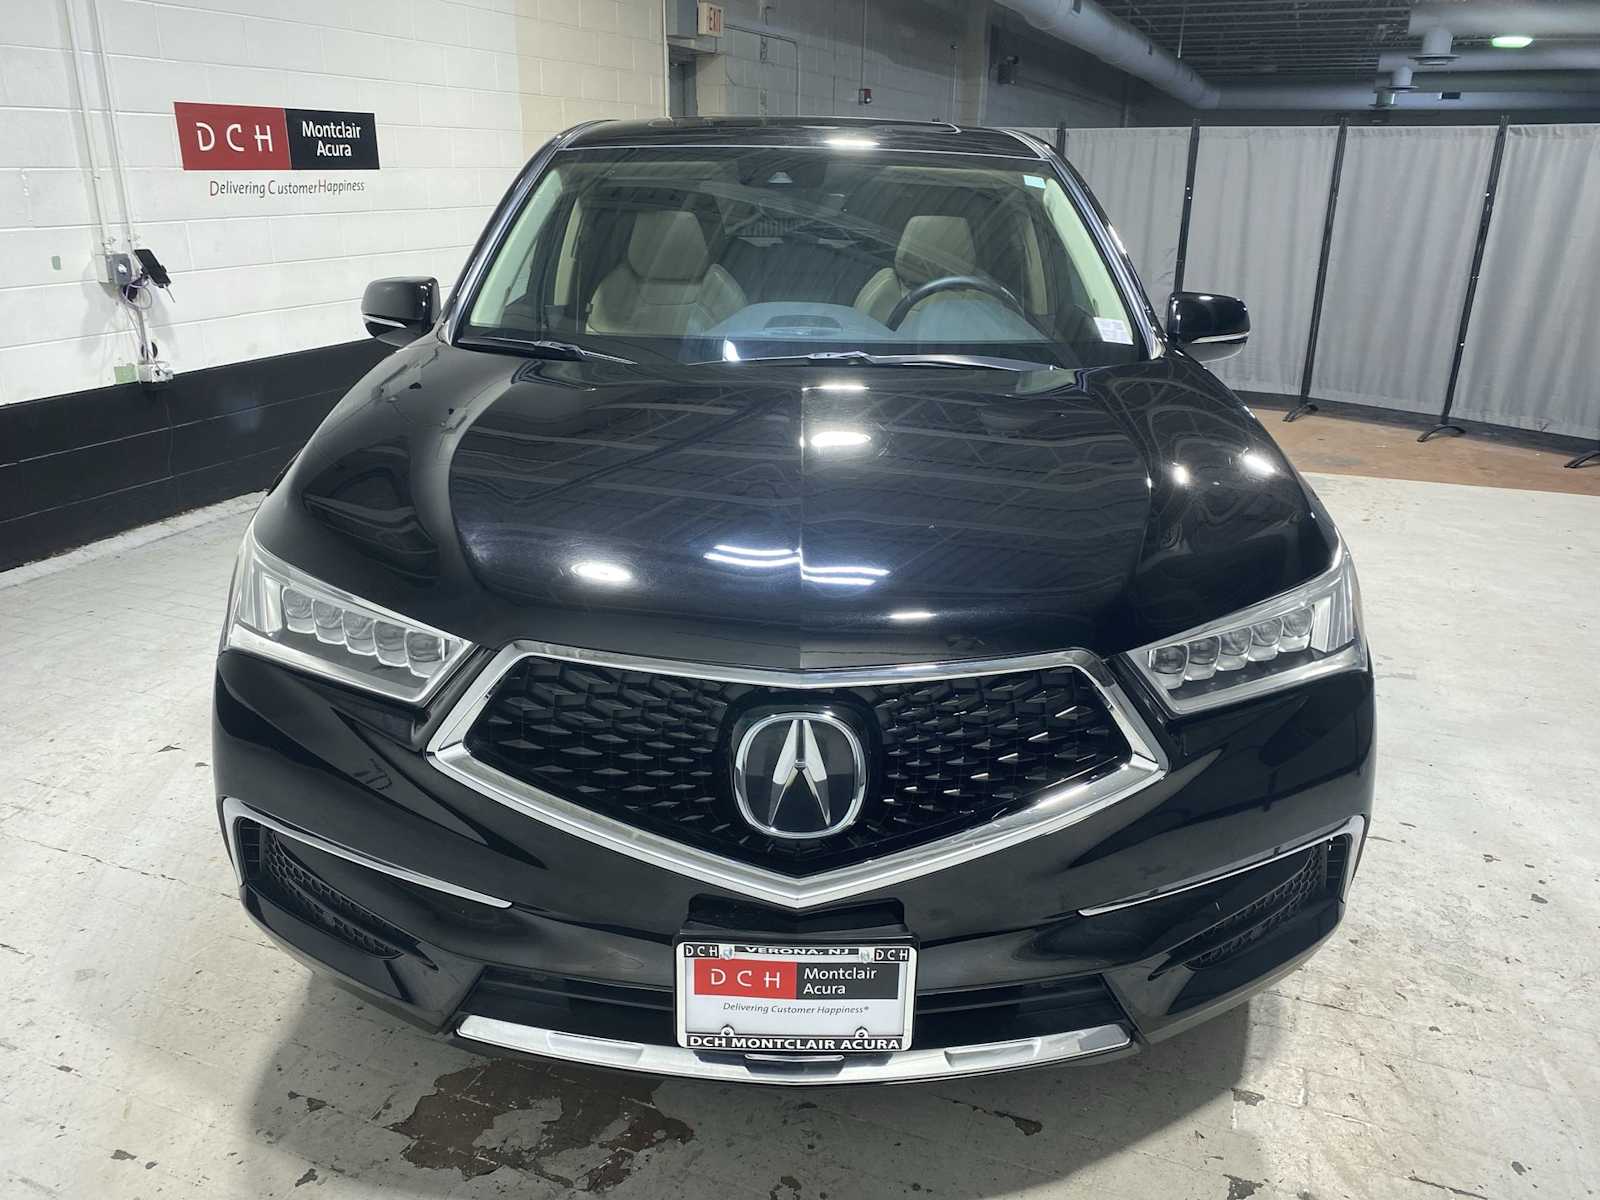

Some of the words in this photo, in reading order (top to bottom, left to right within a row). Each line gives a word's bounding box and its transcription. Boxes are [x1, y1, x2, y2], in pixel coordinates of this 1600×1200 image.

[196, 122, 274, 152] DCH
[302, 121, 361, 139] Montclair
[316, 141, 352, 157] Acura
[209, 180, 265, 198] Delivering
[685, 945, 718, 957] DCH
[875, 949, 908, 961] DCH
[710, 968, 781, 989] DCH
[803, 967, 877, 980] Montclair
[803, 983, 846, 995] Acura
[723, 1002, 769, 1015] Delivering
[771, 1005, 815, 1014] Customer
[689, 1036, 726, 1048] DCH
[731, 1037, 835, 1050] MONTCLAIR
[840, 1039, 900, 1050] ACURA
